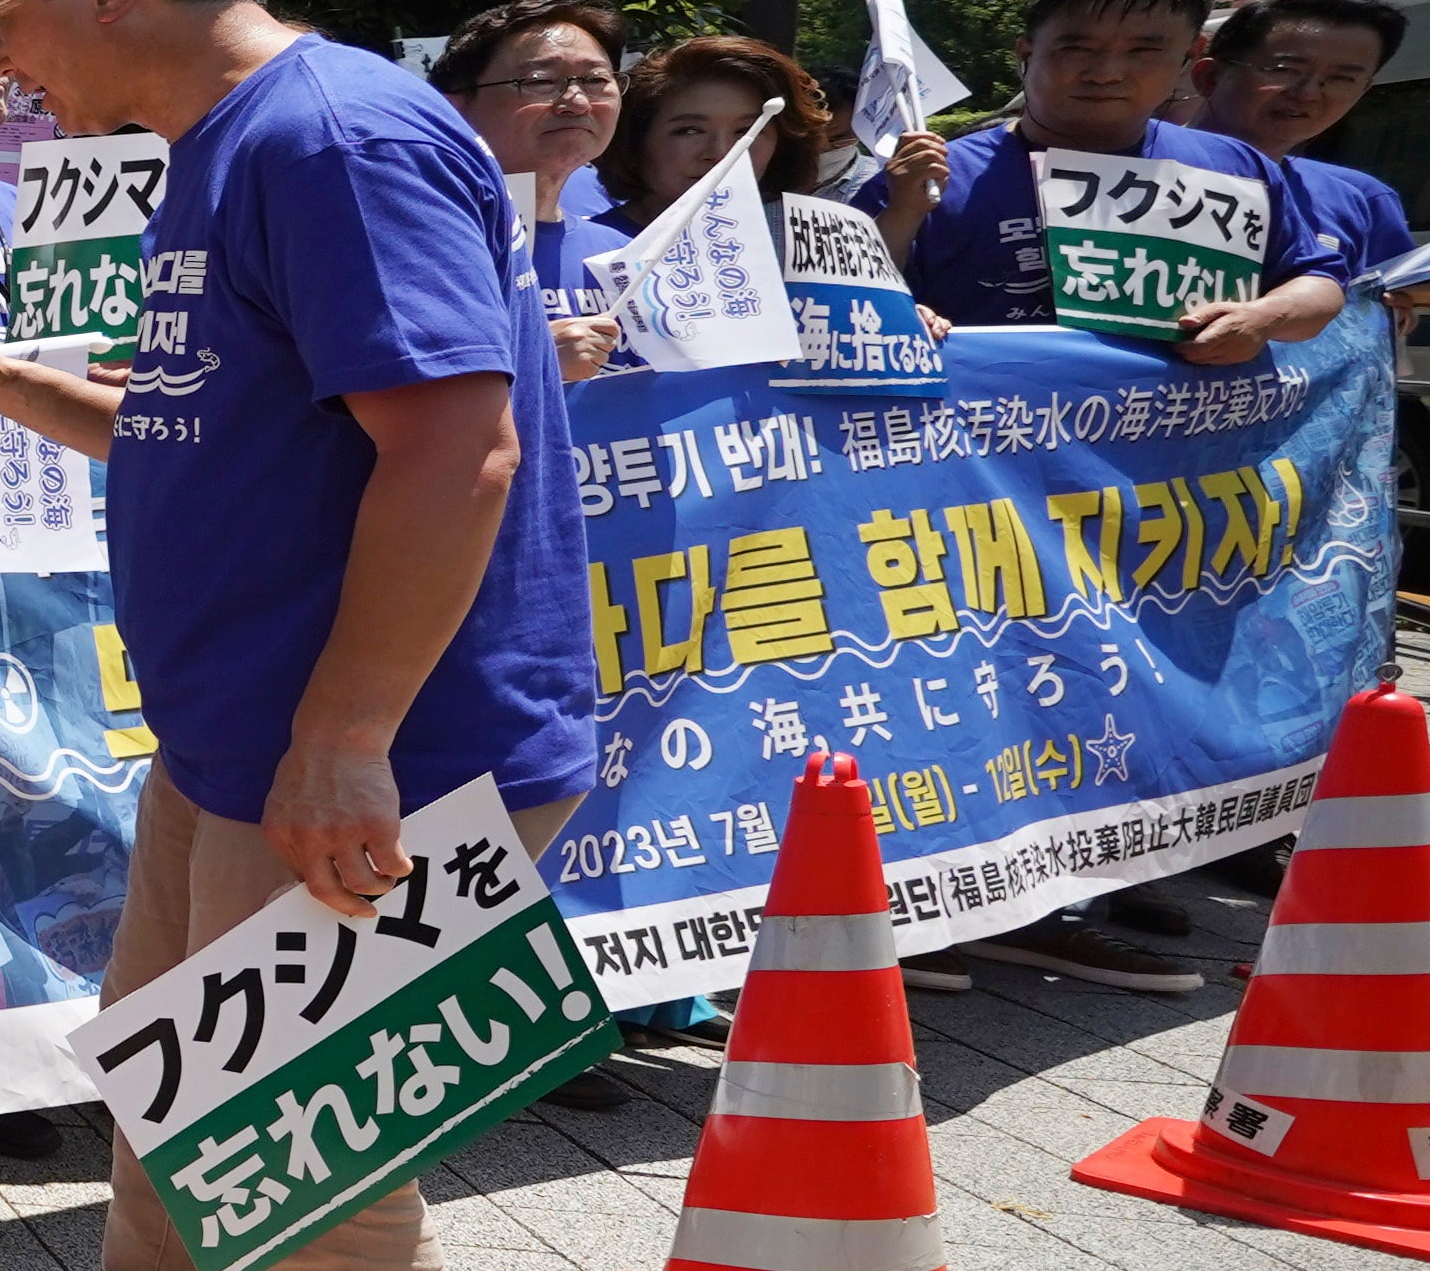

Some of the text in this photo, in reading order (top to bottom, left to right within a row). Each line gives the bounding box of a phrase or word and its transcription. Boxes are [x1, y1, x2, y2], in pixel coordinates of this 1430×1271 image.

[1049, 167, 1266, 252] フクシマを
[704, 186, 761, 319] みんなの海
[713, 412, 822, 493] 반대!
[856, 497, 1047, 641] 함께
[1046, 457, 1303, 604] 지키자!
[559, 814, 707, 883] 2023년
[709, 801, 781, 856] 7월
[583, 925, 669, 977] 저지
[169, 921, 593, 1250] 忘れない!
